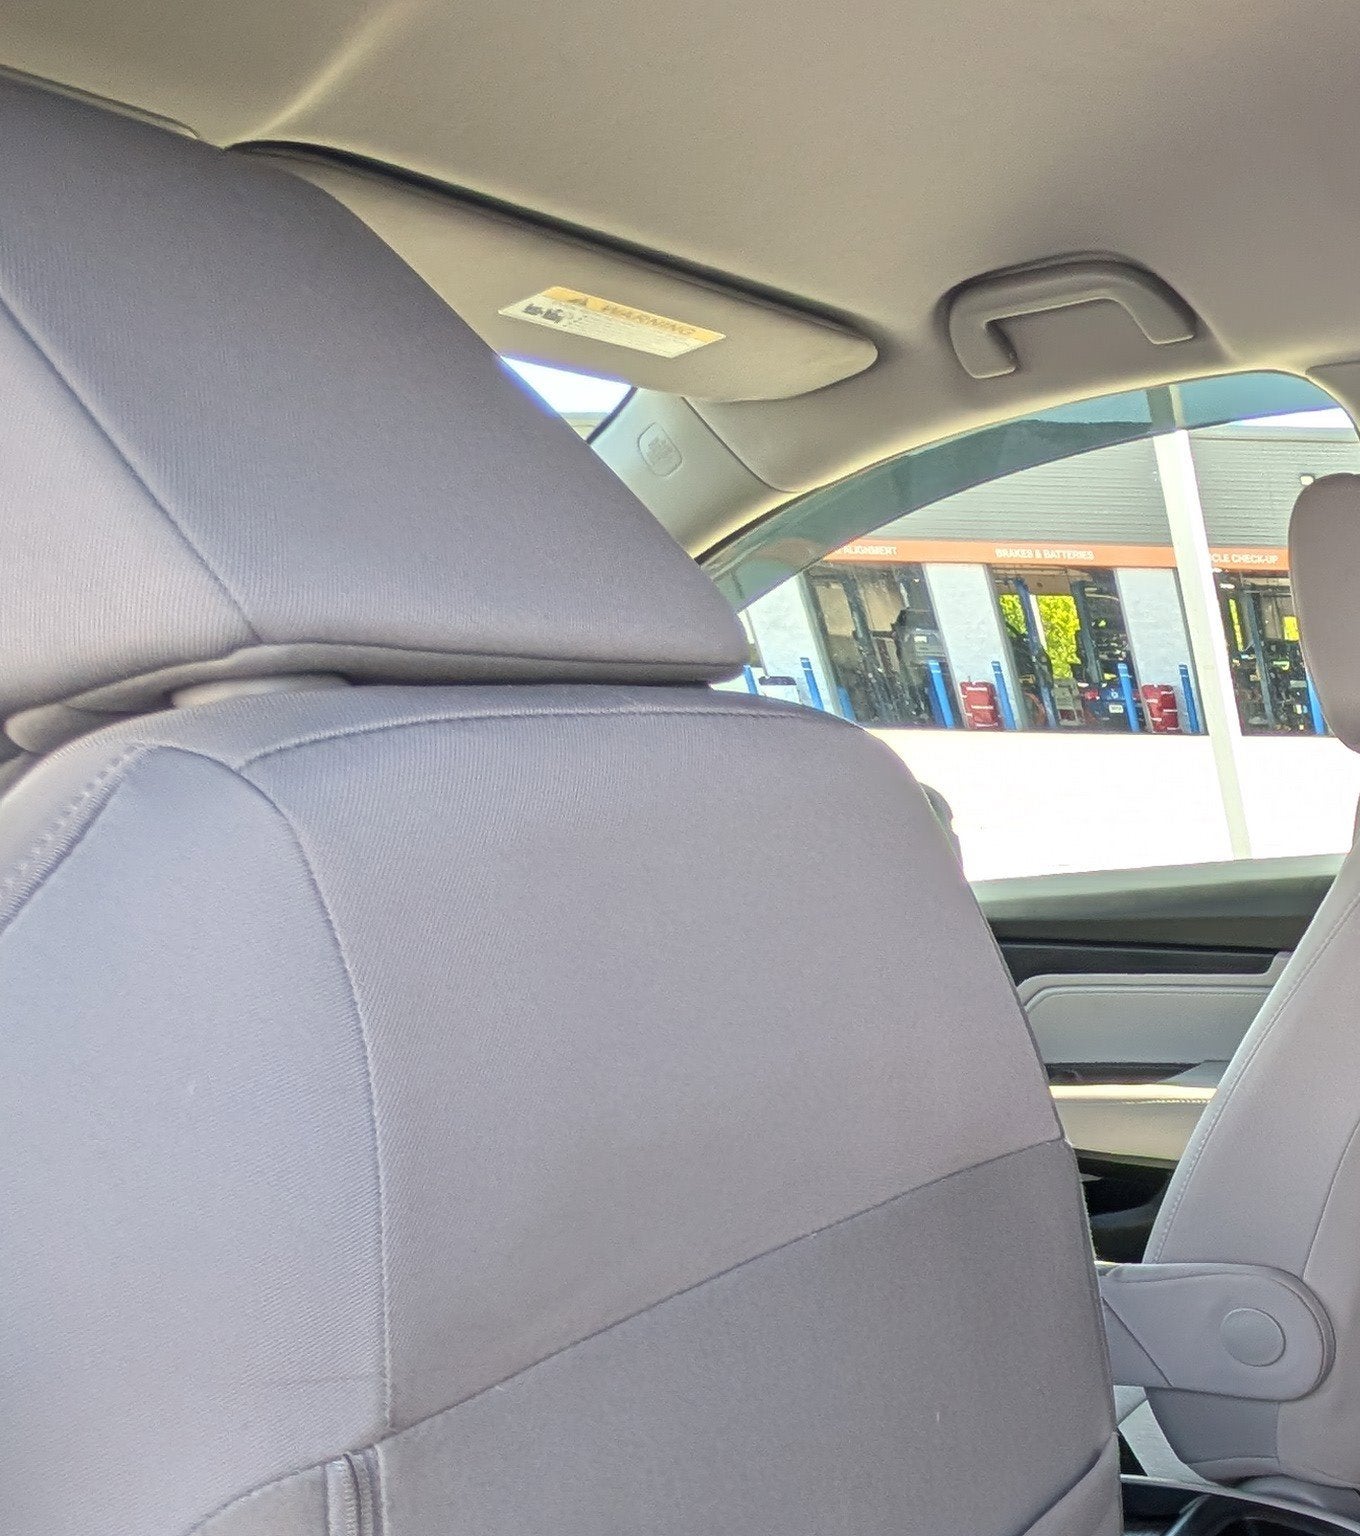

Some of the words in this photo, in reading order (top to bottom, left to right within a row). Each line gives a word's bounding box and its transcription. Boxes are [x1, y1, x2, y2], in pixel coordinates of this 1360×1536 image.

[995, 548, 1034, 559] BRAKES
[1043, 550, 1095, 561] BATTERIES
[1211, 553, 1230, 563] CLE
